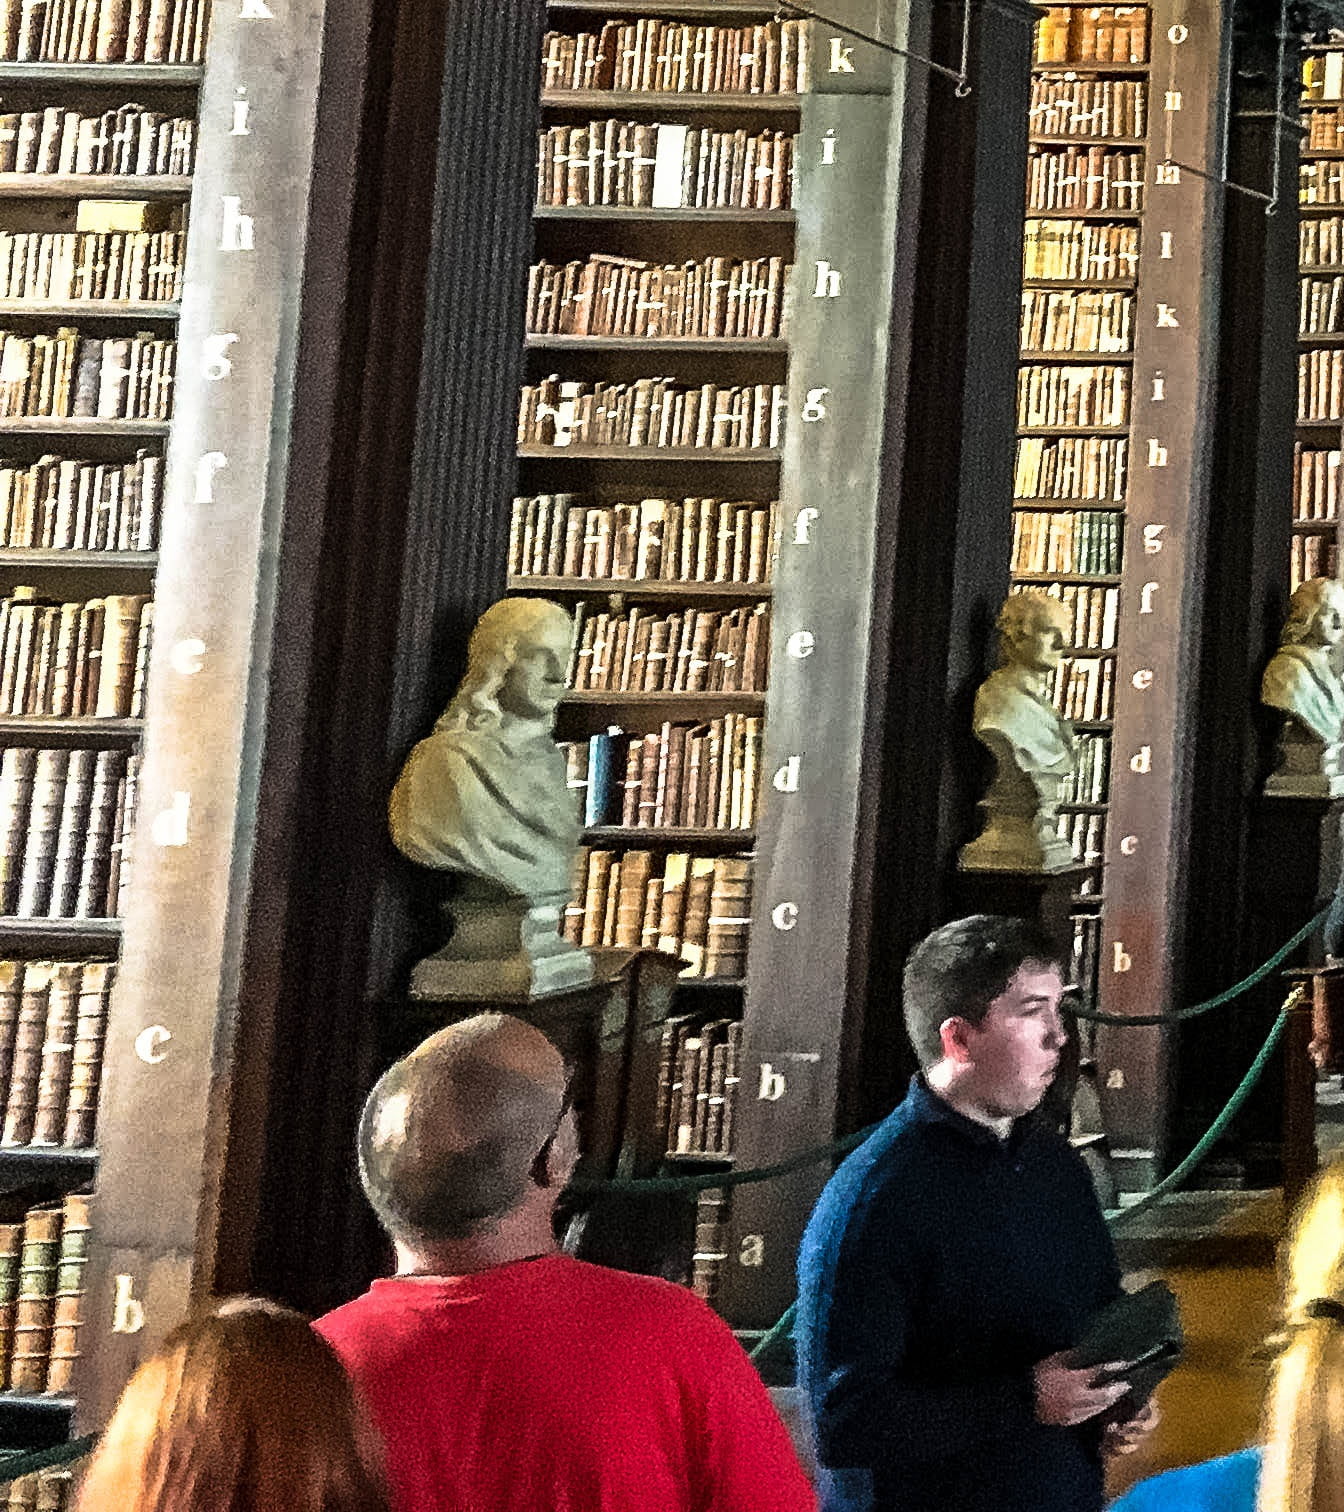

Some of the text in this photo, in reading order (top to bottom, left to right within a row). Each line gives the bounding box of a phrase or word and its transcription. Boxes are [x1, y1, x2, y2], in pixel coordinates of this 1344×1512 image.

[1168, 25, 1188, 44] o
[828, 38, 855, 73] k
[231, 88, 250, 135] i
[1165, 91, 1182, 111] n
[819, 128, 837, 166] i
[218, 196, 254, 251] h
[1160, 231, 1172, 258] l
[812, 261, 841, 298] h
[1156, 303, 1180, 327] k
[200, 332, 240, 380] g
[1151, 370, 1165, 401] i
[802, 388, 830, 421] g
[1148, 439, 1168, 466] h
[193, 451, 228, 504] f
[792, 507, 819, 544] f
[1144, 525, 1168, 554] g
[1142, 582, 1159, 613] f
[787, 630, 815, 659] e
[1132, 669, 1153, 689] e
[774, 757, 800, 792] d
[1130, 745, 1151, 774] d
[153, 791, 190, 846] d
[1120, 835, 1138, 855] c
[773, 901, 798, 930] c
[1113, 942, 1131, 972] b
[135, 1025, 172, 1064] c
[758, 1063, 784, 1100] b
[738, 1234, 765, 1266] a
[112, 1274, 145, 1333] b
